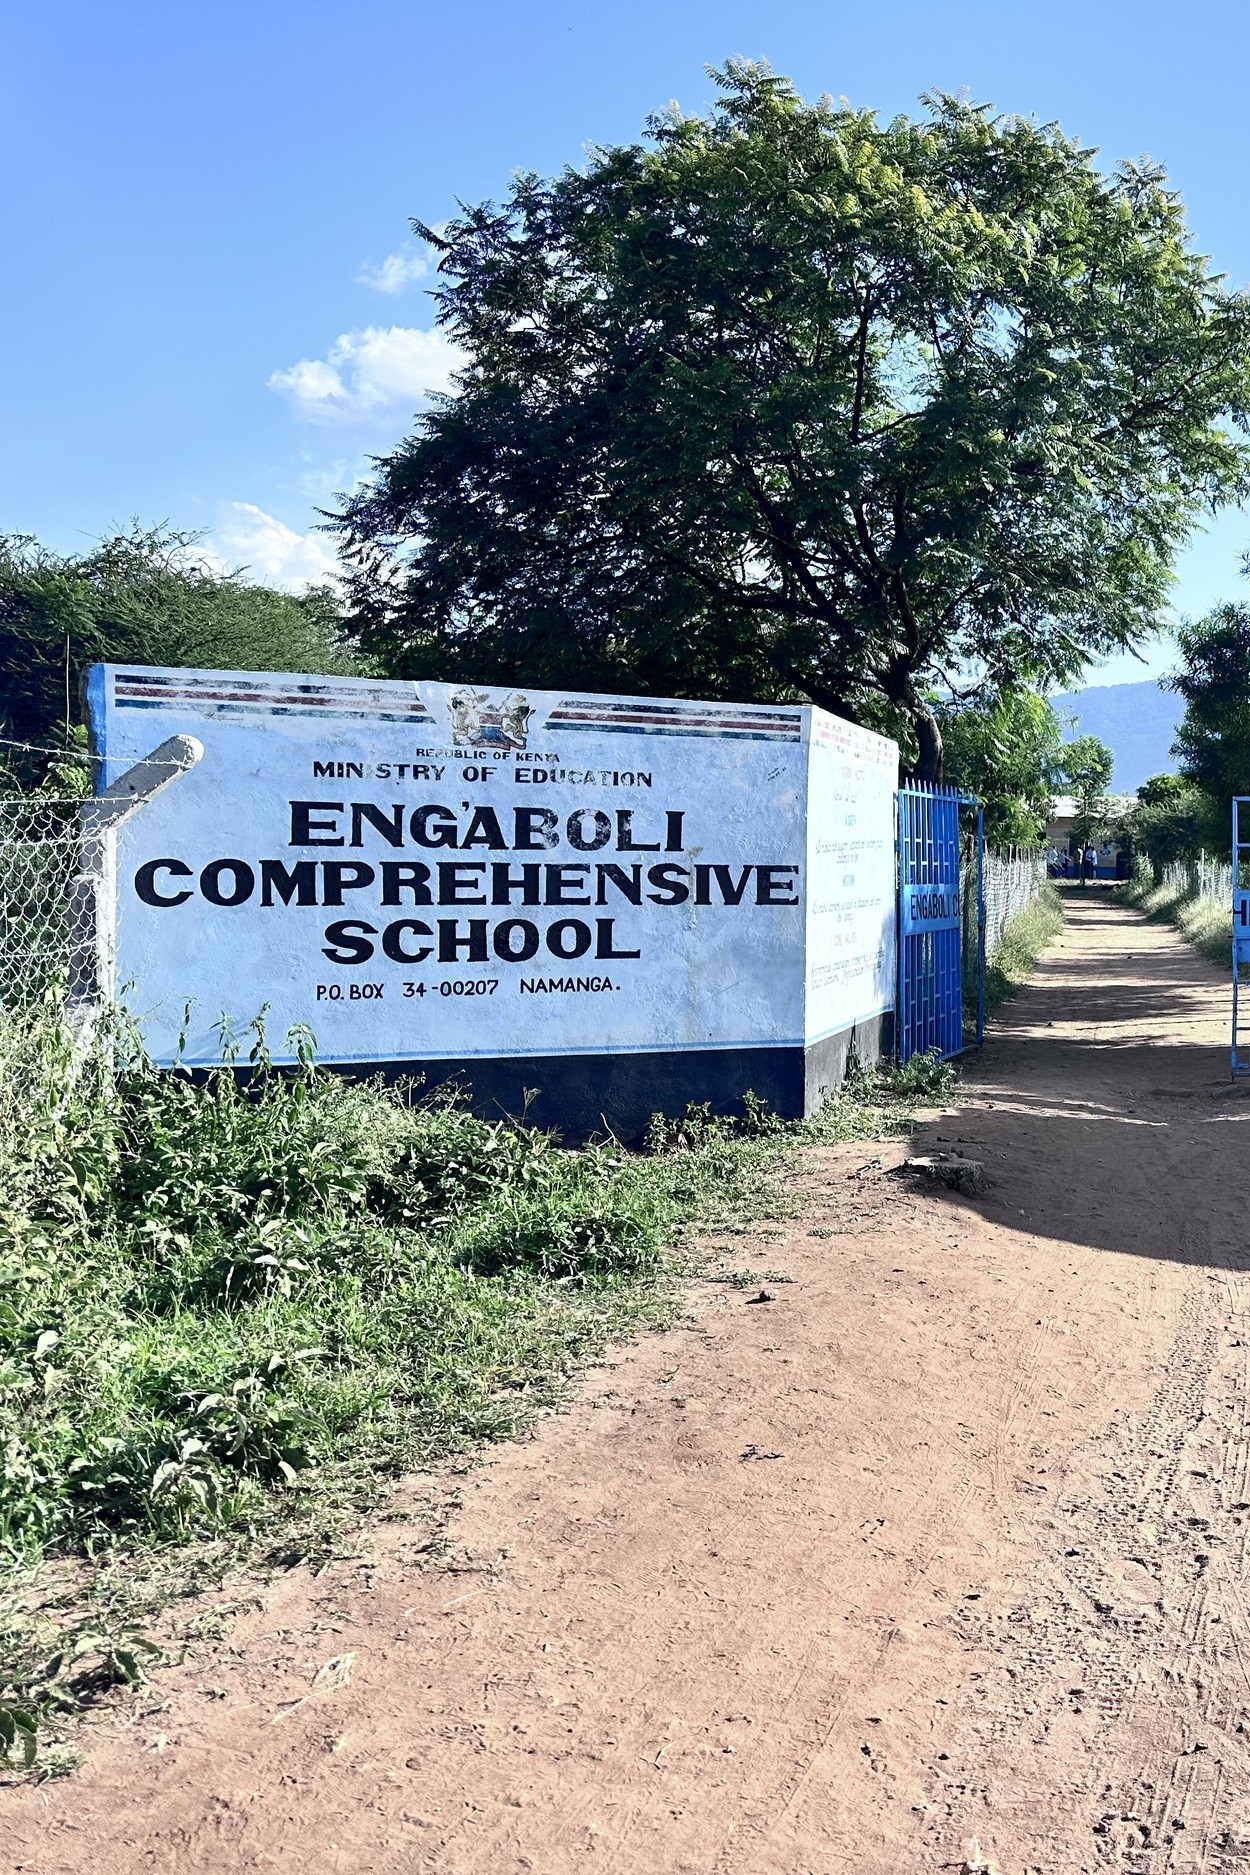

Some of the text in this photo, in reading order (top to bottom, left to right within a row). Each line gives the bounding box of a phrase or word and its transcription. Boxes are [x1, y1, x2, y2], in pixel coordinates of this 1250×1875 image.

[493, 751, 511, 760] OF
[516, 752, 560, 763] KENYA
[463, 766, 498, 783] OF
[514, 767, 653, 788] EDUCATION
[288, 800, 686, 852] ENG'ABOLI
[134, 858, 800, 908] COMPREHENSIVE
[321, 918, 642, 965] SCHOOL
[316, 984, 344, 1001] P.O.
[350, 983, 385, 1000] BOX
[520, 976, 621, 994] NAMANGA.
